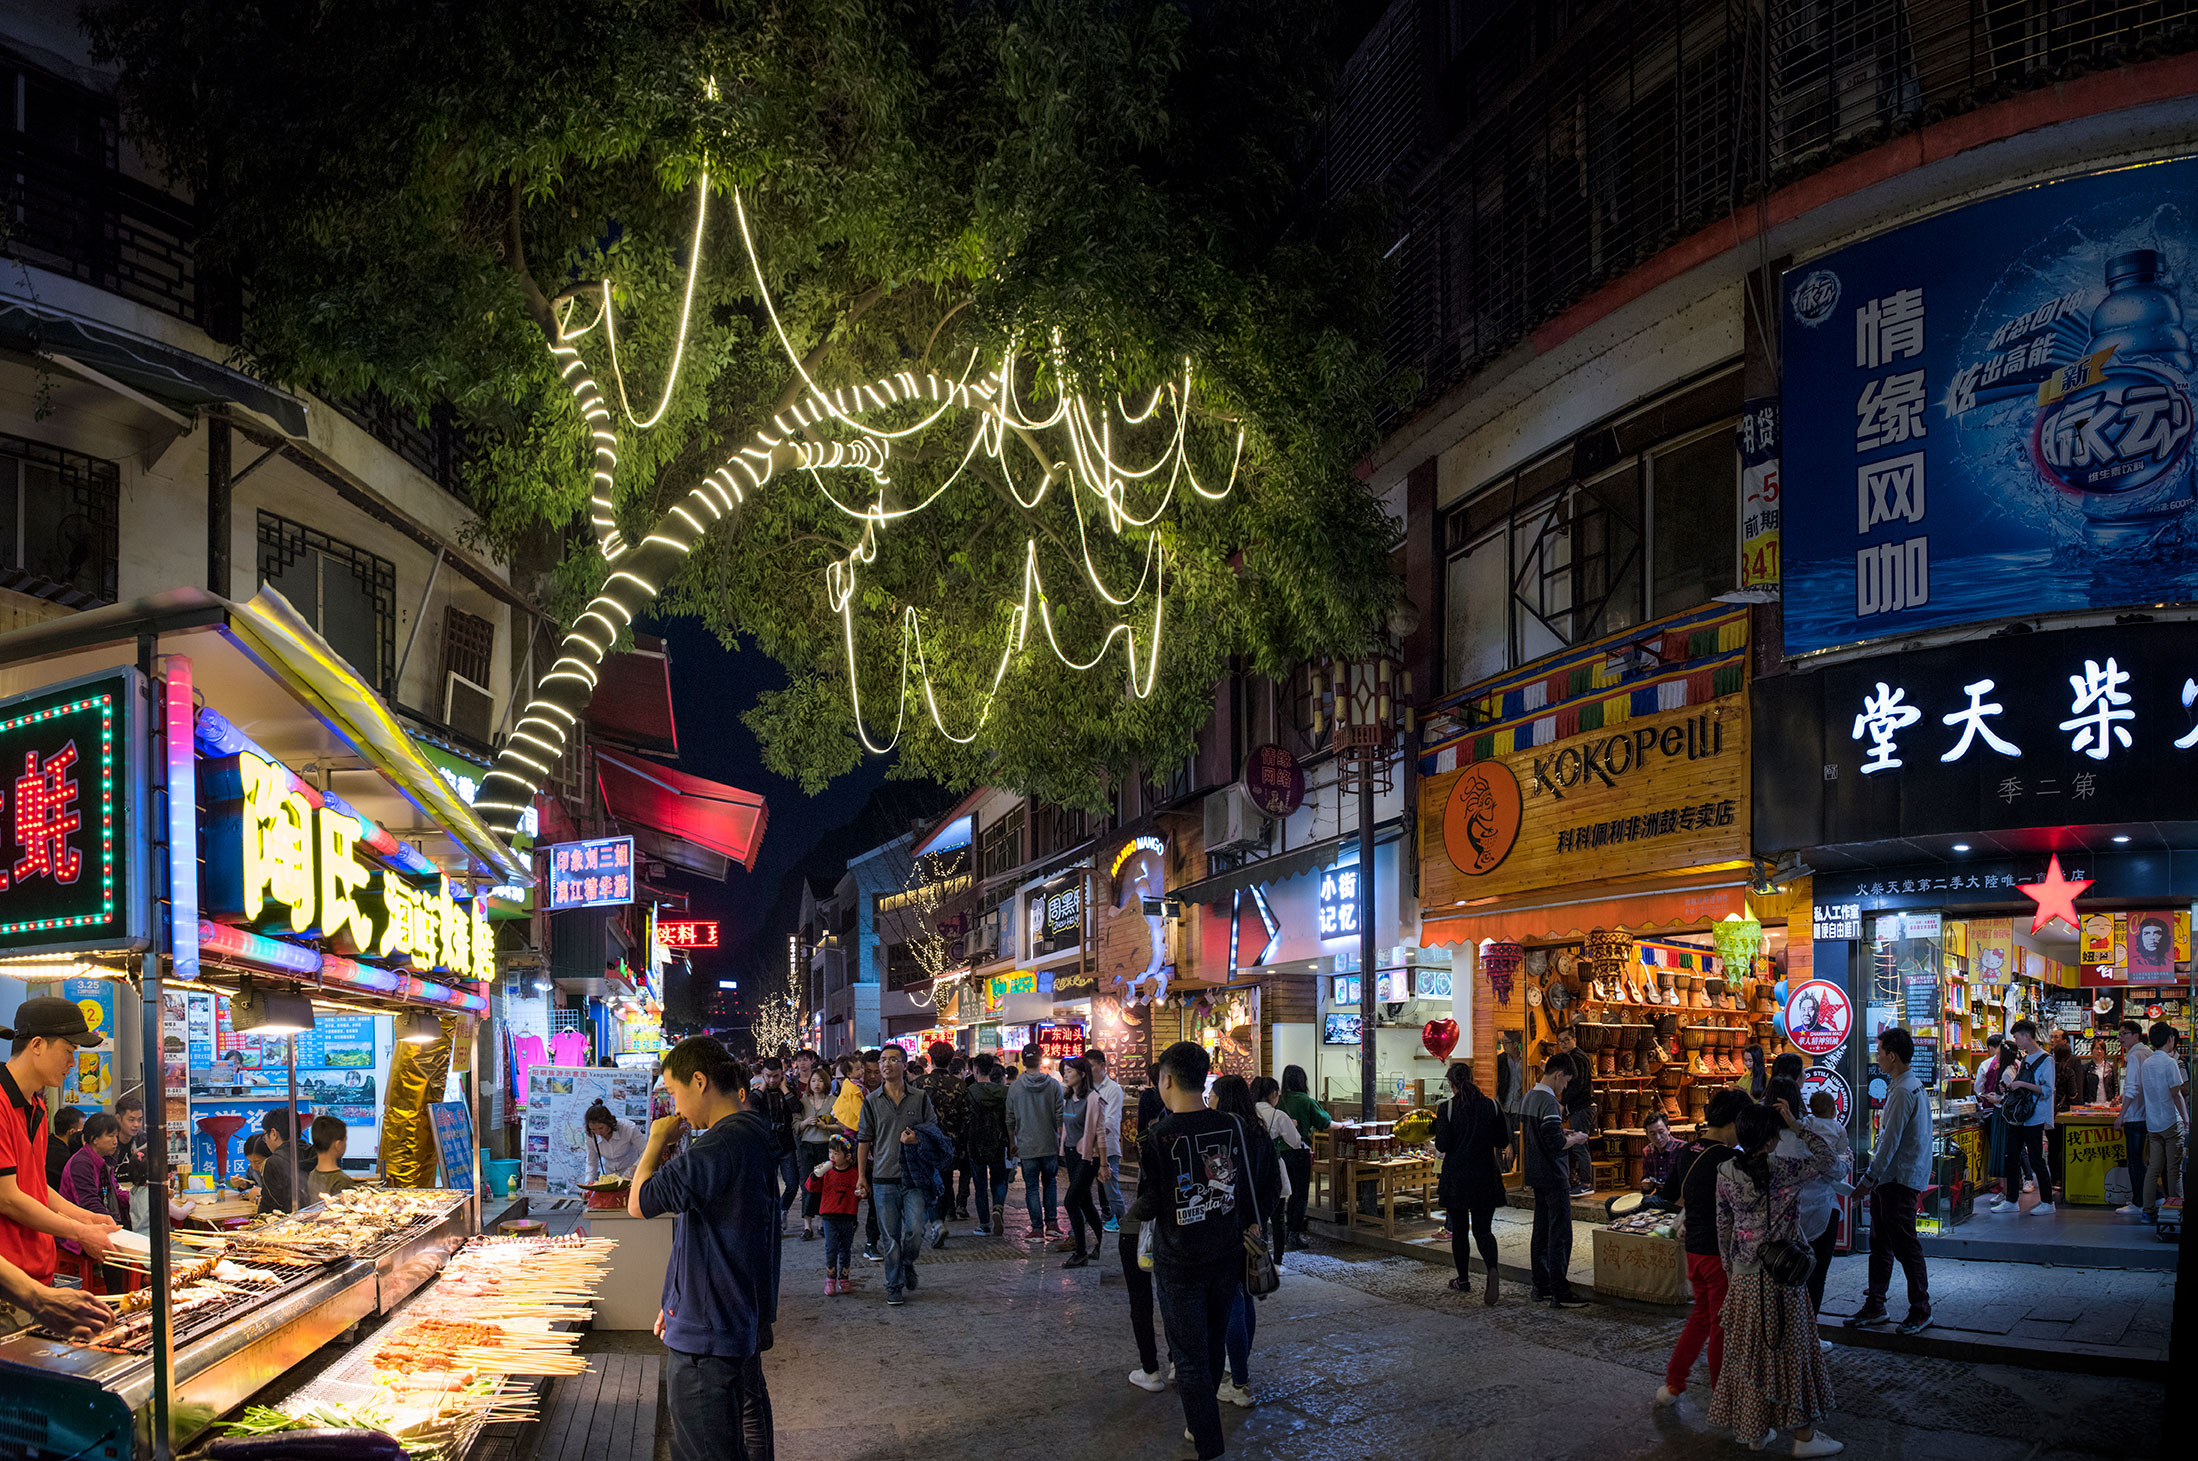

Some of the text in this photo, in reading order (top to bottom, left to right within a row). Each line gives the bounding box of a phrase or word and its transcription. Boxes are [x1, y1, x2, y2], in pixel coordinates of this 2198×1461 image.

[1945, 332, 2059, 419] 炫出高能
[2060, 357, 2095, 393] 新
[1856, 287, 1929, 617] 情缘网咖
[2088, 459, 2145, 483] 维生素饮料
[0, 738, 82, 888] 蚝
[1556, 800, 1736, 854] 科科佩利非洲鼓专卖店
[556, 844, 630, 873] 印象刘三姐
[1136, 835, 1164, 856] MANGO
[556, 873, 629, 903] 漓江精华游
[1320, 872, 1357, 901] 小街
[1855, 869, 2085, 897] 火柴天堂第二季大陸唯一直店
[1319, 904, 1357, 933] 记忆
[1814, 904, 1860, 921] 私人工作室
[657, 924, 698, 945] 实料
[77, 980, 100, 990] 3.25
[1040, 1027, 1083, 1042] 广东汕头
[634, 1073, 648, 1081] Map
[1178, 1206, 1205, 1219] LOVERS
